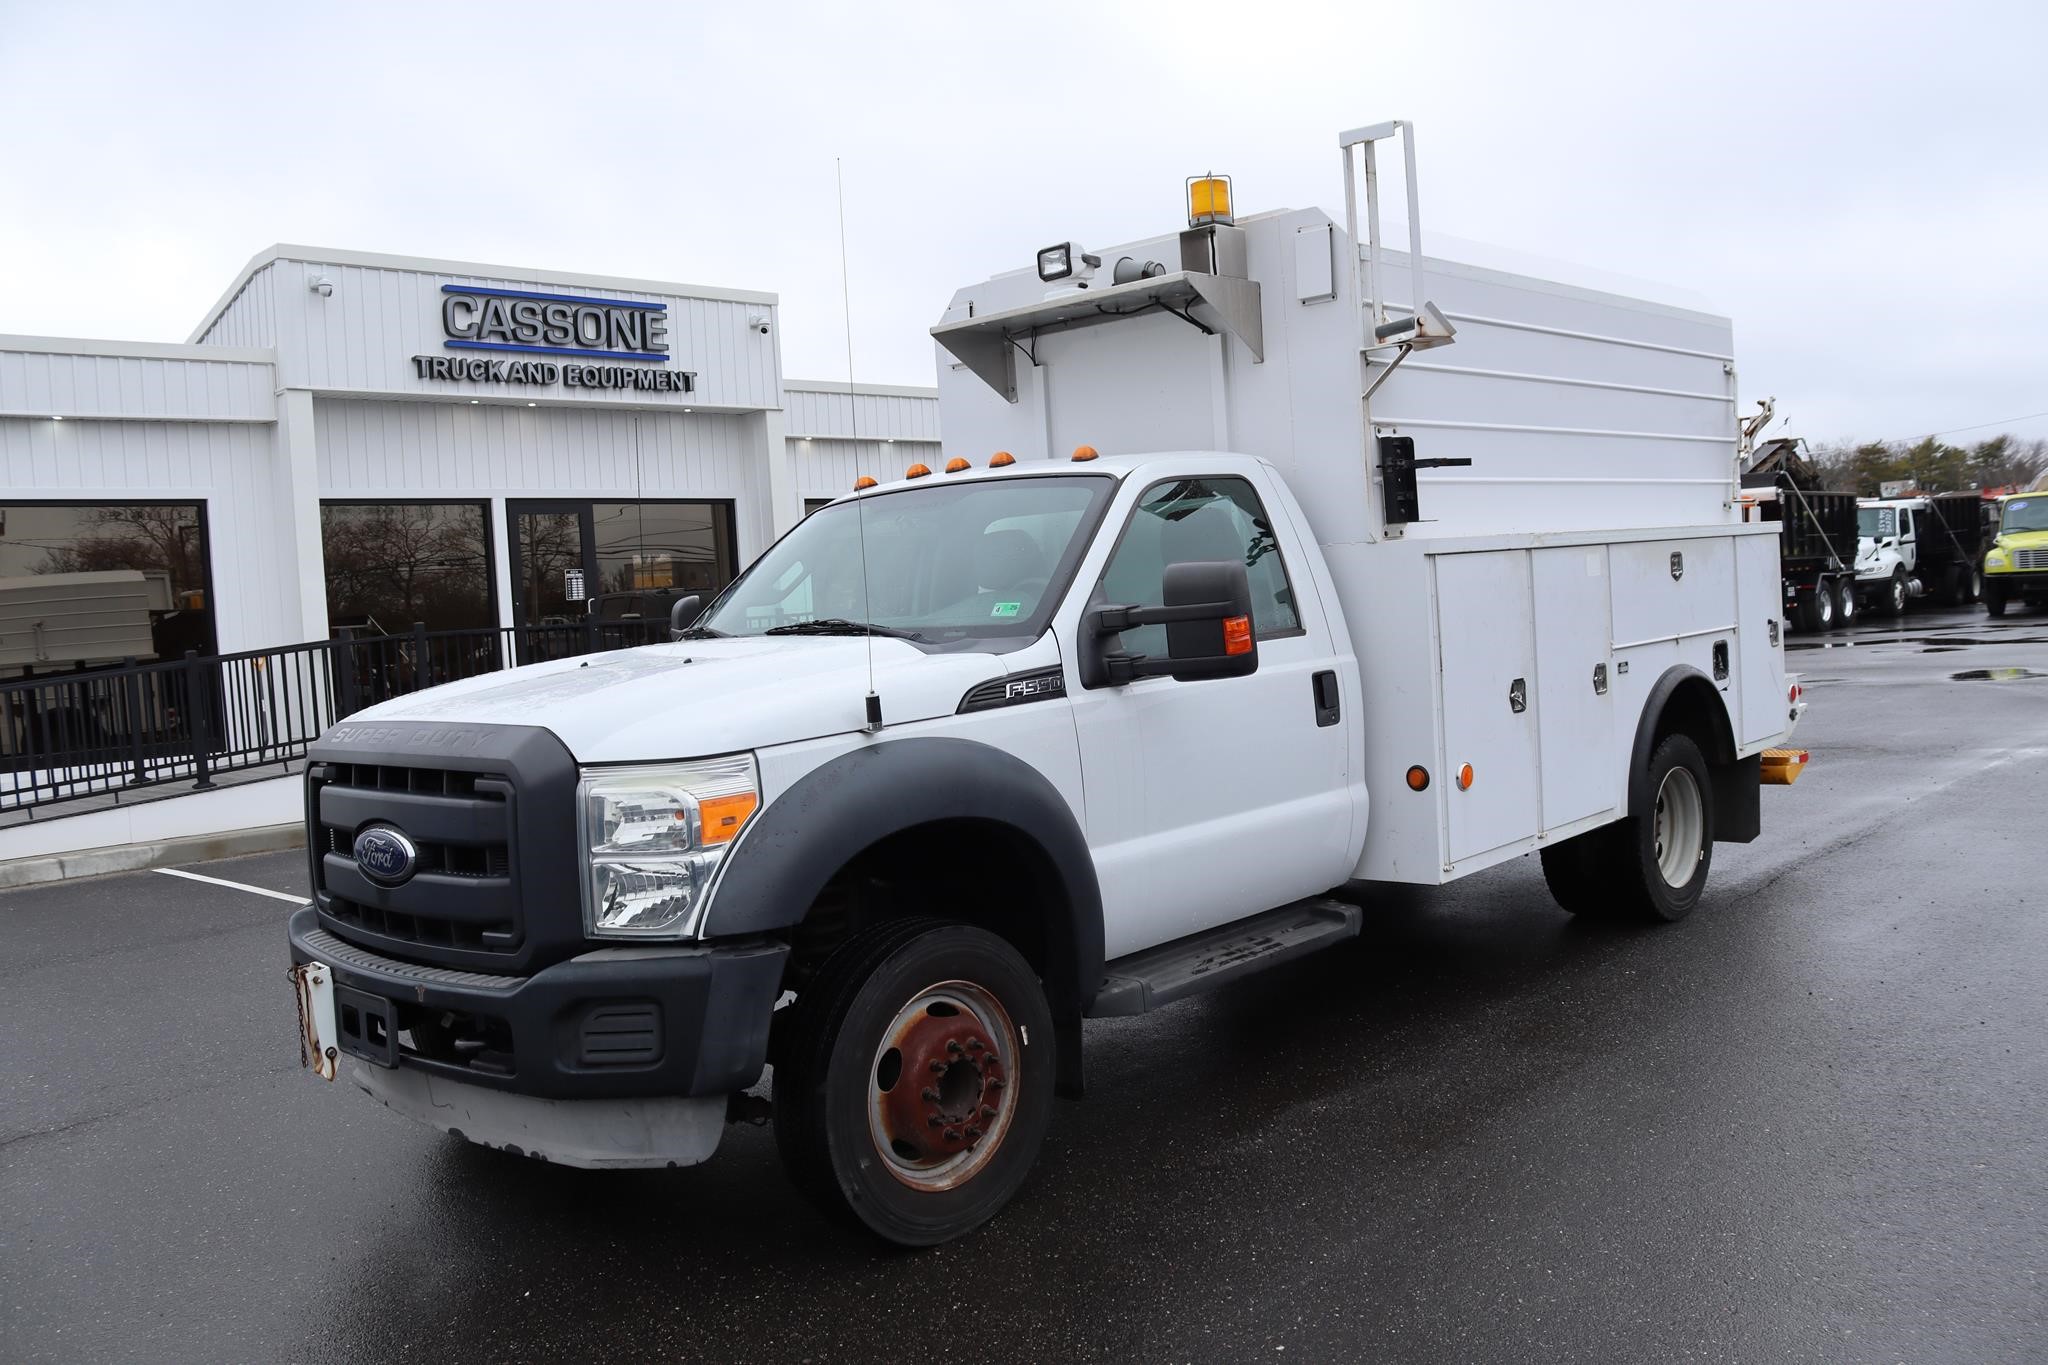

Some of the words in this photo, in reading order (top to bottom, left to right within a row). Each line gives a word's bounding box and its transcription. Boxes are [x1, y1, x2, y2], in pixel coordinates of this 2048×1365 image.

[442, 295, 669, 351] CASSONE
[412, 355, 505, 383] TRUCK
[505, 361, 559, 385] AND
[563, 364, 697, 392] EQUIPMENT
[1006, 676, 1063, 699] F-550
[330, 728, 401, 744] SUPER
[407, 729, 497, 750] DUTY
[362, 836, 393, 868] Ford
